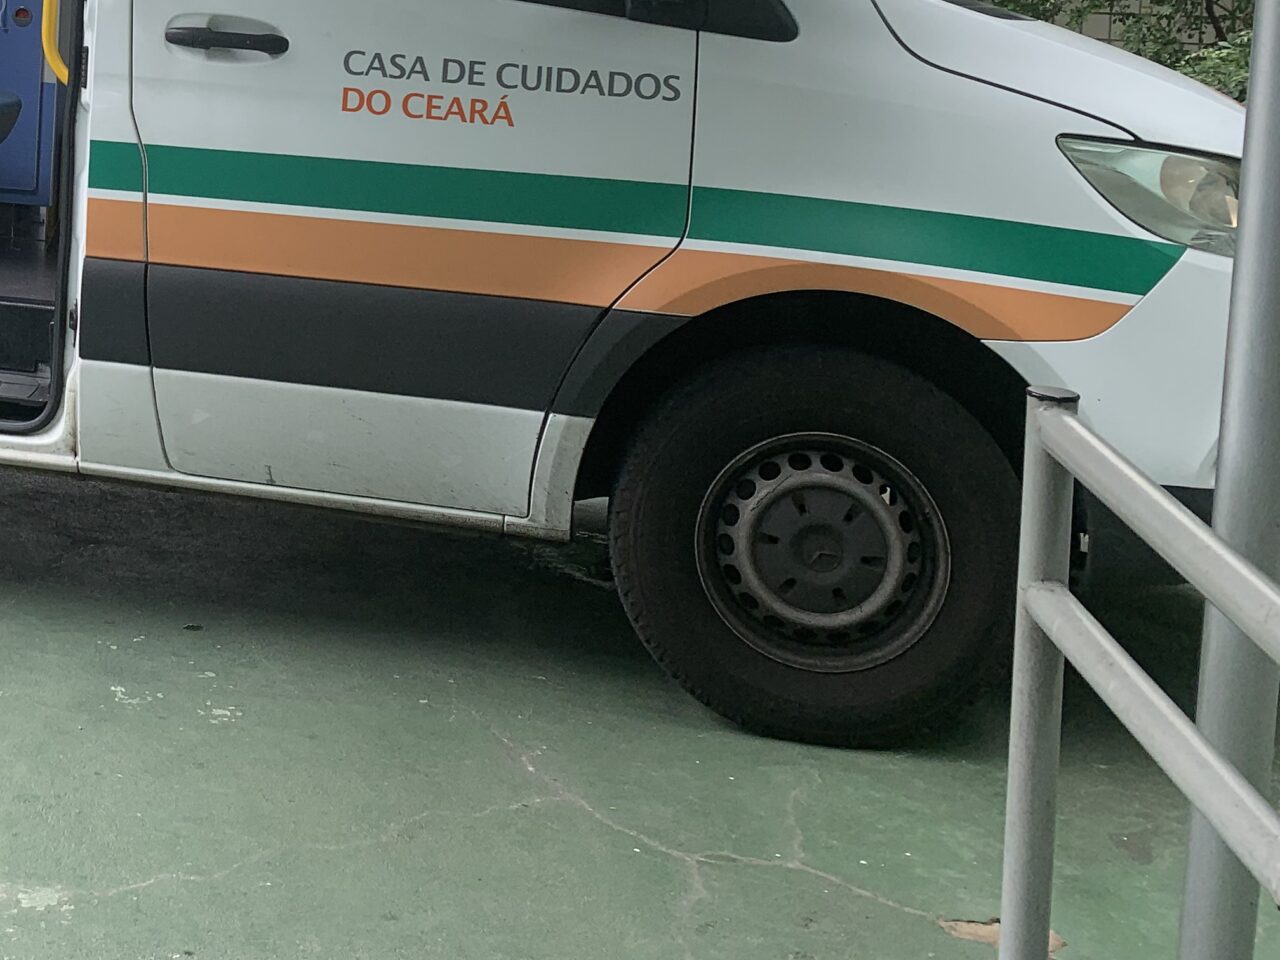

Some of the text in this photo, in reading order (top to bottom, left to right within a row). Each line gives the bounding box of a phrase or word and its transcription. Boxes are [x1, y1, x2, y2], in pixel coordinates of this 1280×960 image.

[343, 50, 682, 102] CASA DE CUIDADOS
[341, 87, 515, 127] DO CEARÁ
